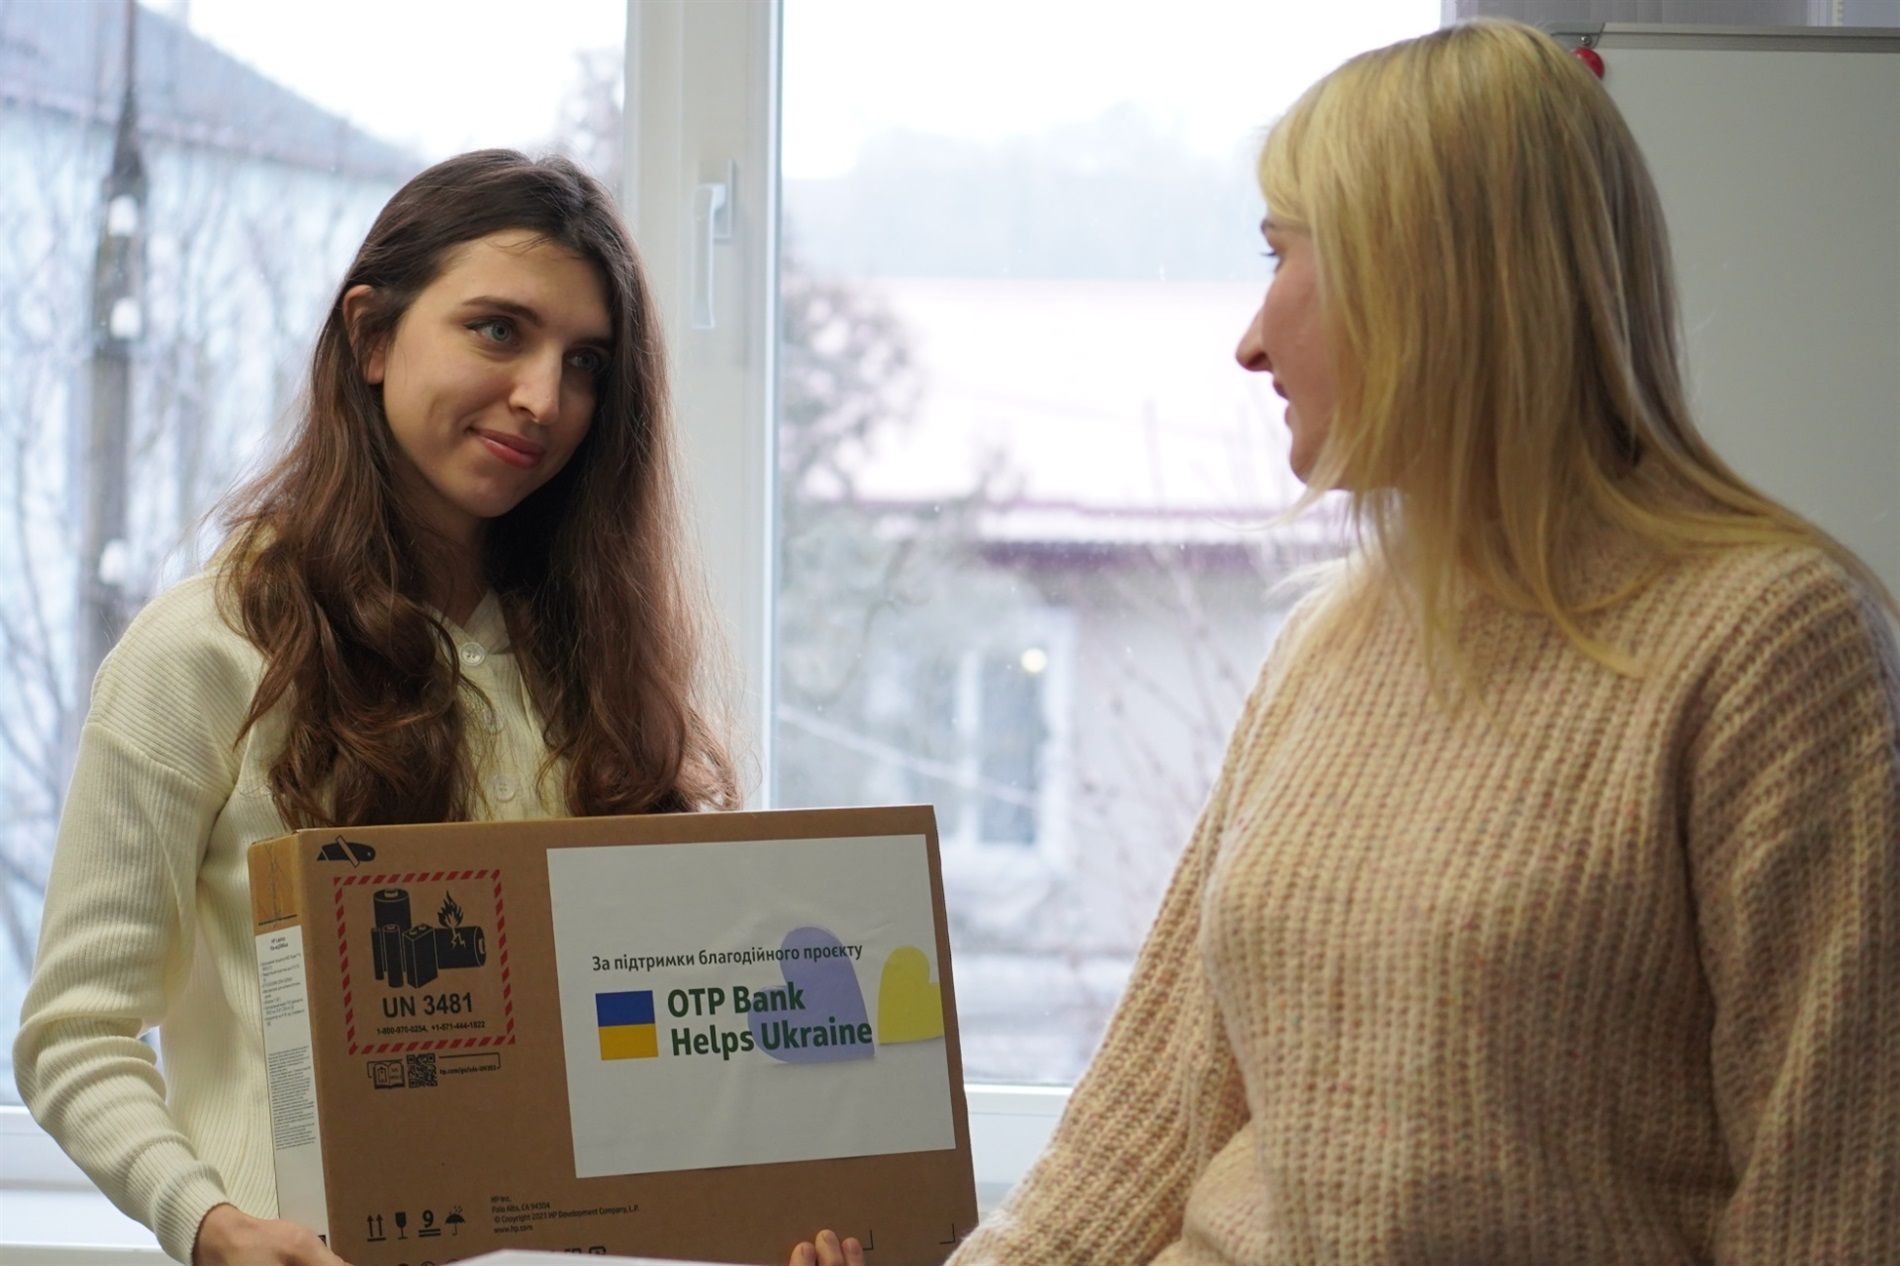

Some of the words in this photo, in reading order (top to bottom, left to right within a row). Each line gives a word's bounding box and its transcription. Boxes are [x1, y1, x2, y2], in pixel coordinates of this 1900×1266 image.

[591, 956, 610, 971] За
[614, 954, 695, 972] підтримки
[698, 946, 799, 965] благодійного
[803, 944, 863, 963] проєкту
[382, 995, 416, 1018] UN
[423, 992, 472, 1015] 3481
[667, 986, 725, 1018] OTP
[733, 981, 806, 1013] Bank
[671, 1024, 755, 1061] Helps
[761, 1016, 872, 1050] Ukraine
[422, 1209, 434, 1228] 9
